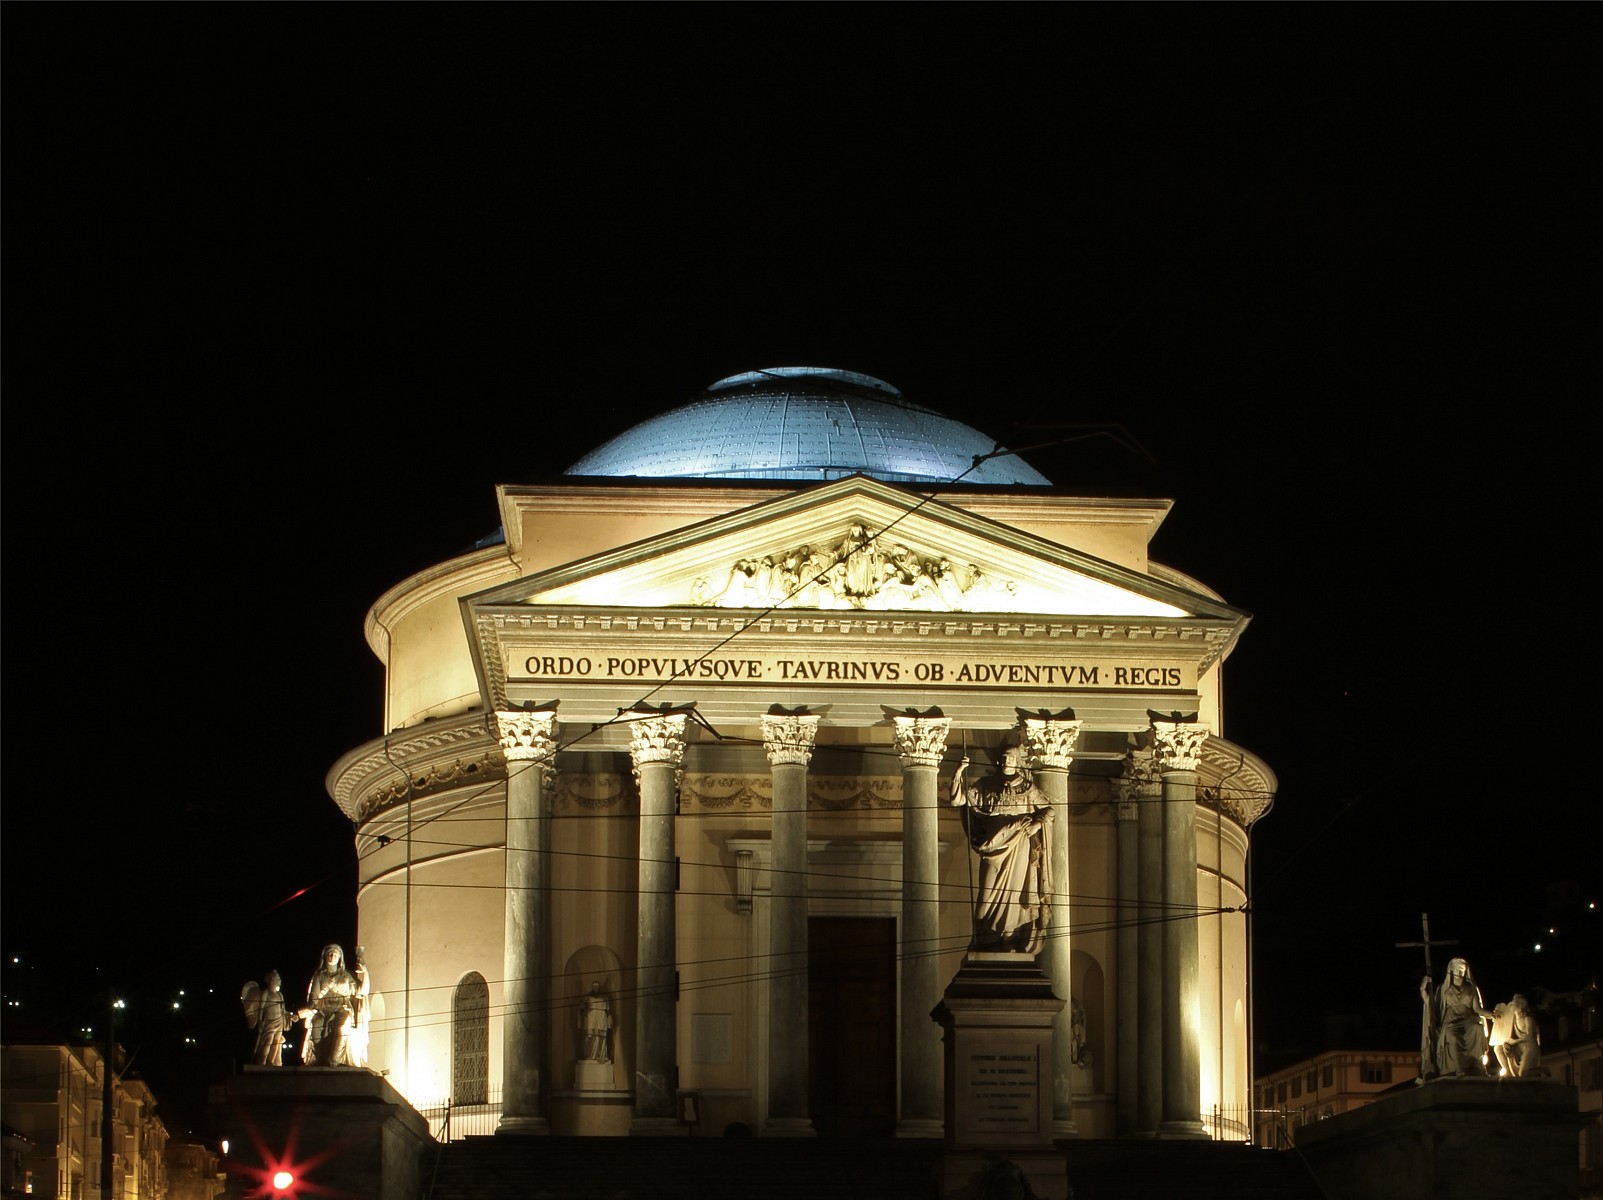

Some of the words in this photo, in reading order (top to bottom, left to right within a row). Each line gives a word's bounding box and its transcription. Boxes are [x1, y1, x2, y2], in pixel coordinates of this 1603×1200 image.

[525, 656, 592, 675] ORDO
[608, 658, 762, 680] POPVLVSQVE
[778, 660, 899, 680] TAVRINVS
[914, 662, 944, 681] OB
[955, 663, 1099, 685] ADVENTVM
[1114, 667, 1181, 686] REGIS
